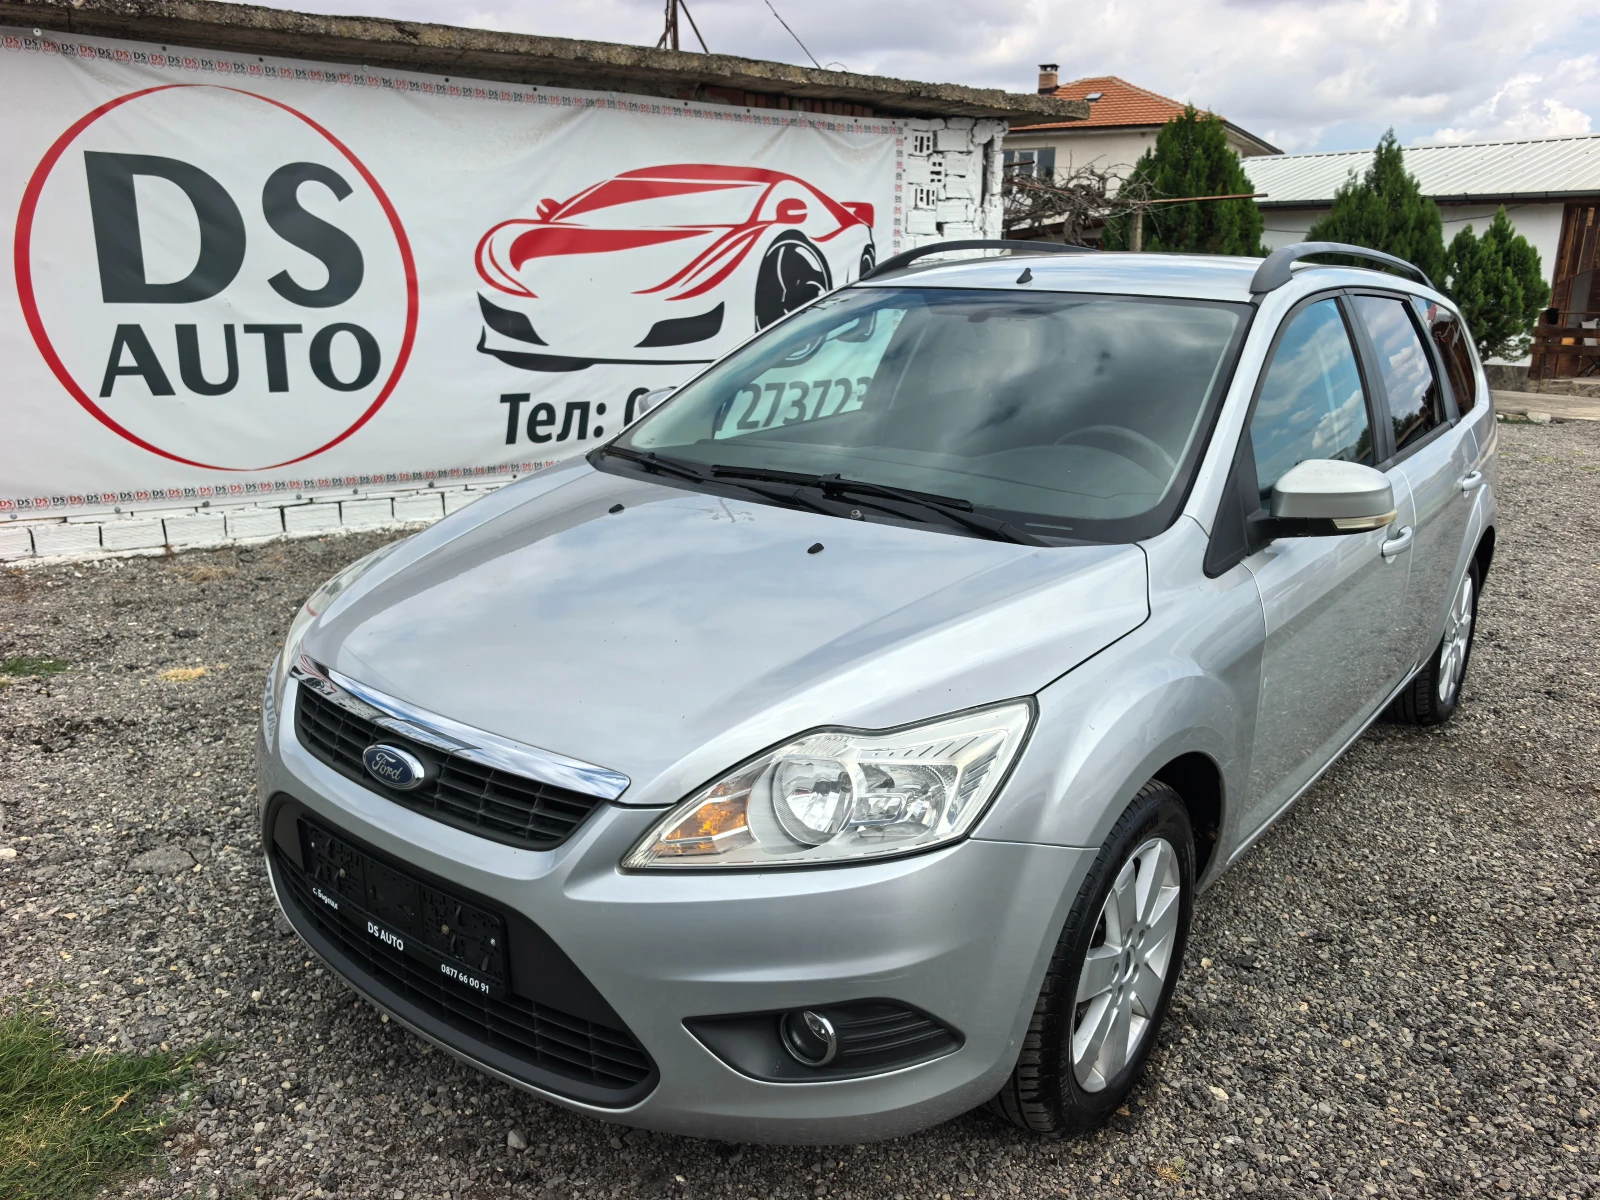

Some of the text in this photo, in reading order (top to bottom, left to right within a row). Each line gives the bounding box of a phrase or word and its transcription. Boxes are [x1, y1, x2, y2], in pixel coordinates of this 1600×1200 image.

[5, 36, 18, 44] DS
[24, 38, 37, 46] DS
[43, 40, 56, 49] DS
[116, 50, 128, 58] DS
[84, 150, 364, 308] DS
[99, 322, 381, 398] AUTO
[500, 392, 607, 445] Тел:
[372, 752, 403, 780] Ford
[367, 921, 404, 951] DS AUTO
[441, 964, 489, 994] 0877 66 00 91
[1059, 1073, 1073, 1108] SPIRIT
